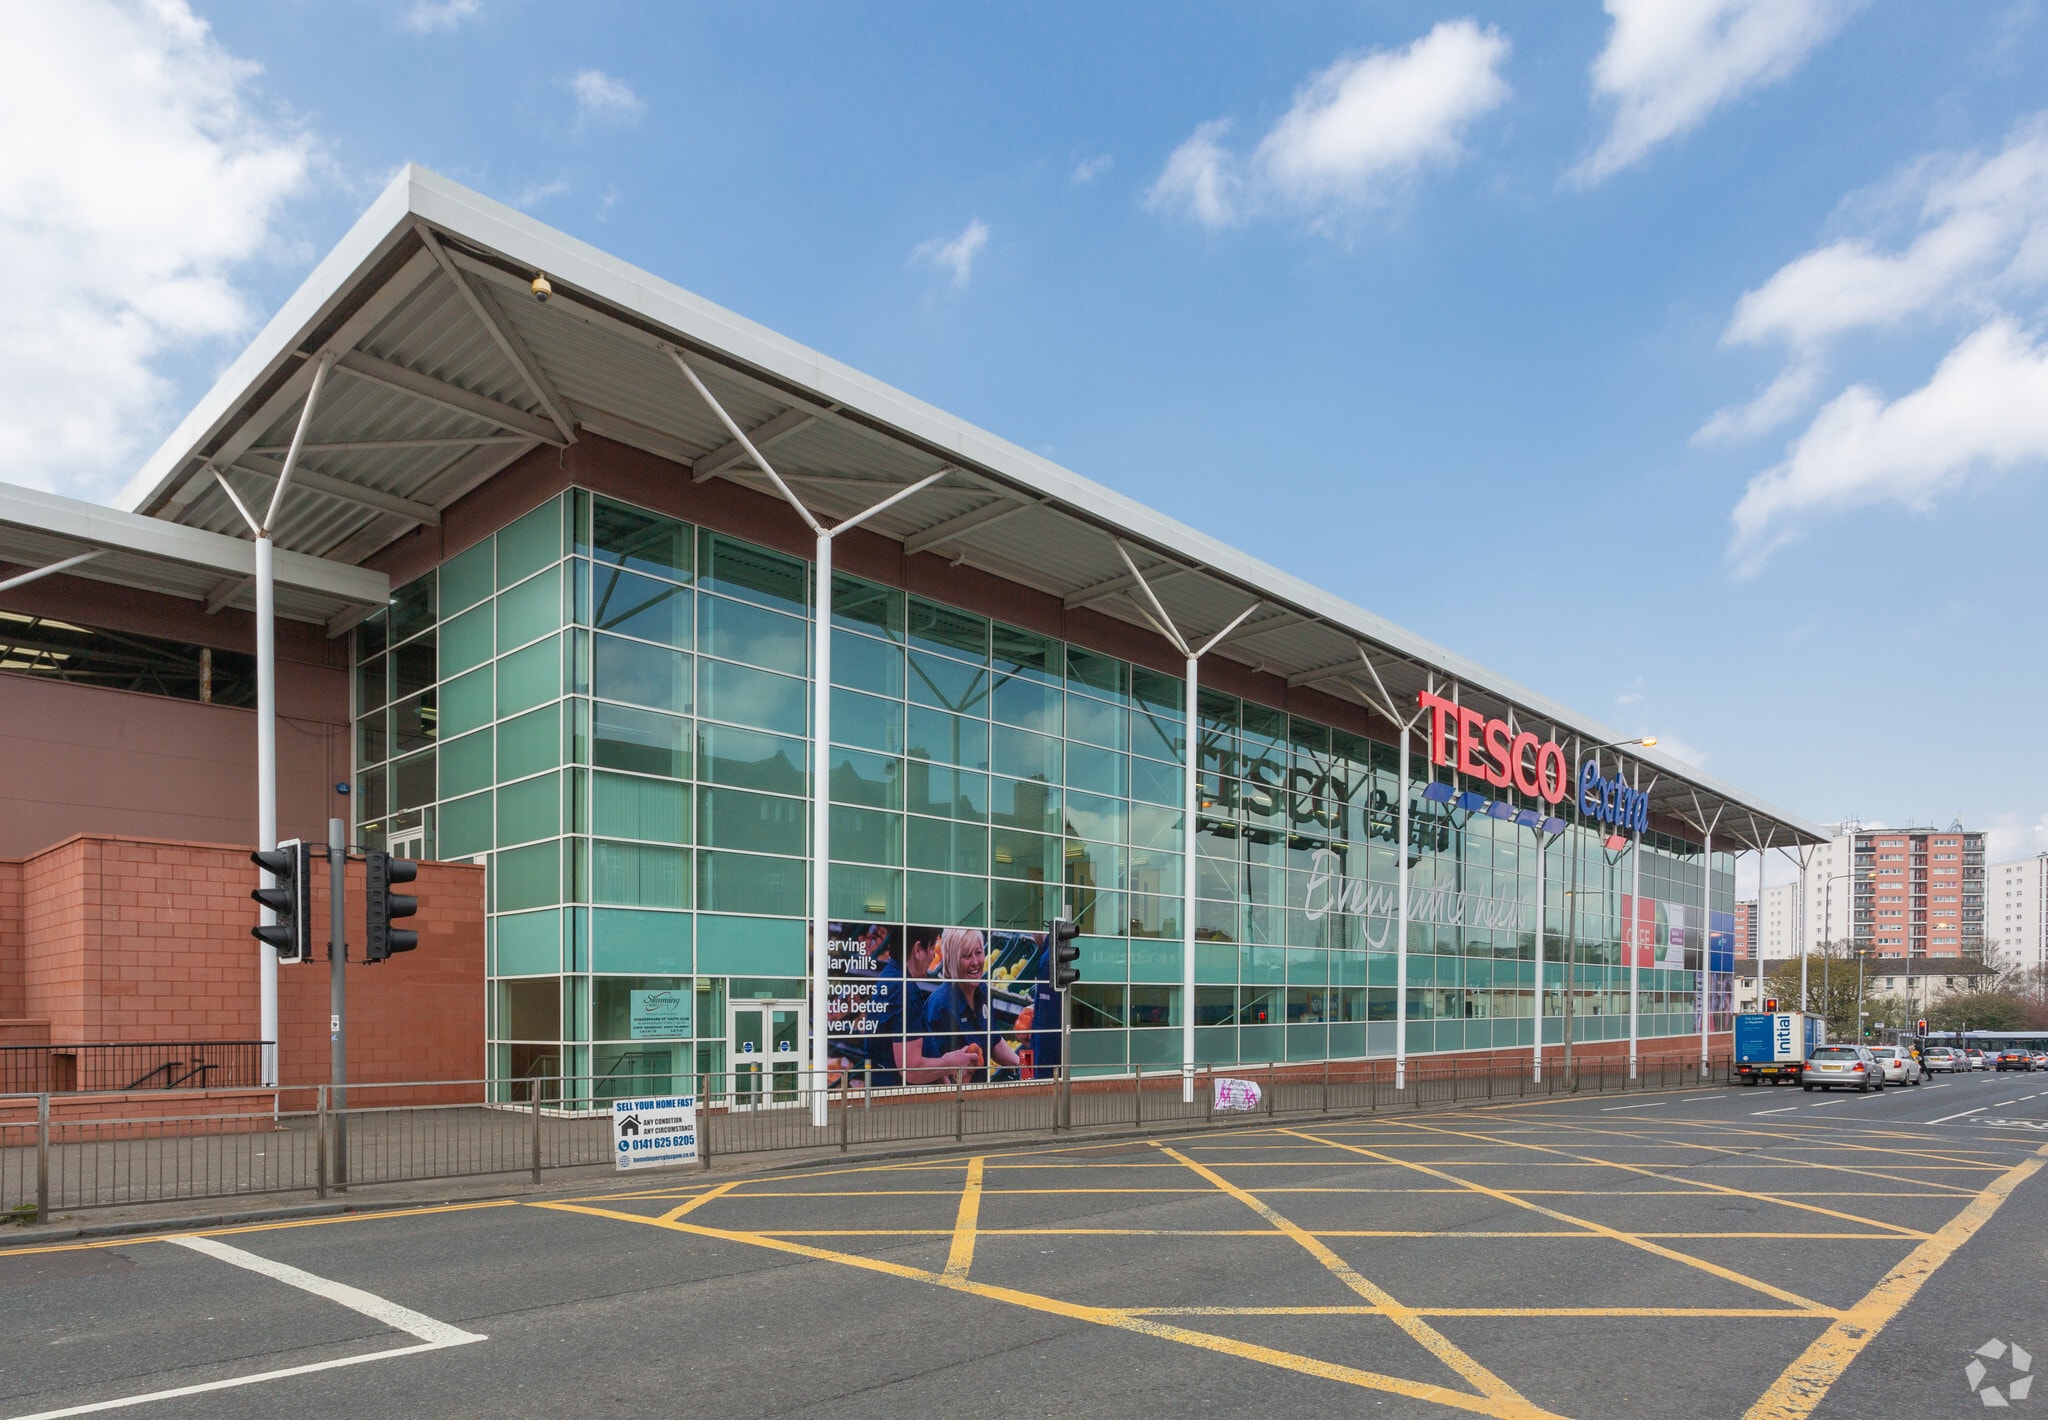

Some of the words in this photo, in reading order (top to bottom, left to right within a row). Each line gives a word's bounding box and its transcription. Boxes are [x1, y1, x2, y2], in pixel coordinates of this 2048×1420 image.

[1418, 690, 1567, 805] TESCO
[1579, 759, 1649, 834] extra
[1305, 848, 1394, 949] Every
[1471, 880, 1529, 944] helps
[828, 937, 867, 956] erving
[828, 981, 878, 999] hoppers
[880, 984, 888, 995] a
[850, 999, 890, 1013] better
[828, 1020, 855, 1035] very
[857, 1017, 879, 1034] day
[1777, 1015, 1791, 1054] Initial
[616, 1102, 633, 1112] SELL
[634, 1100, 655, 1111] YOUR
[655, 1099, 676, 1109] HOME
[677, 1098, 694, 1107] FAST
[643, 1127, 654, 1135] ANY
[654, 1125, 694, 1134] CIRCUMSTANCE
[654, 1117, 683, 1125] CONDITION
[632, 1139, 653, 1150] 0141
[654, 1137, 672, 1149] 625
[673, 1135, 695, 1147] 6205
